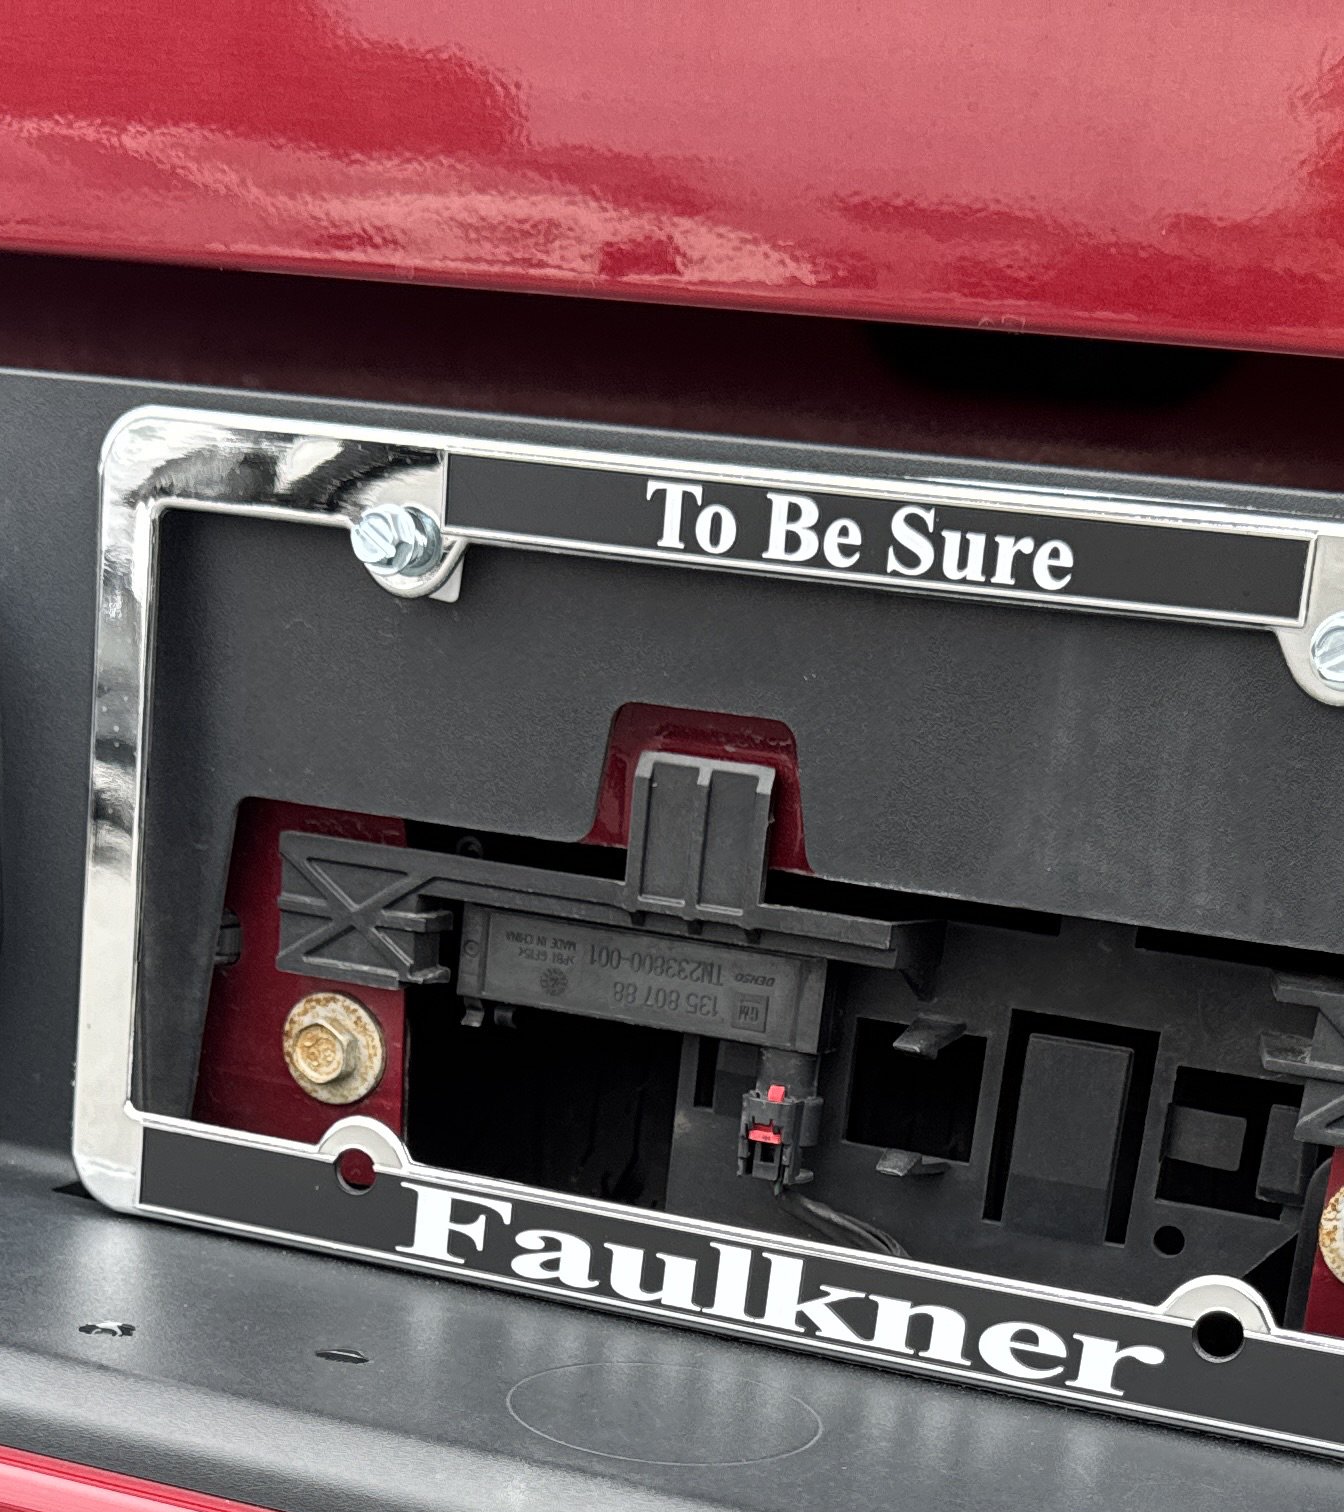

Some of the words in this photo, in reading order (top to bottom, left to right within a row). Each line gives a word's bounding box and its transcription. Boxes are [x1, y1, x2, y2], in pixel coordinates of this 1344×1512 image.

[646, 479, 736, 554] To
[761, 492, 862, 568] Be
[886, 505, 1075, 591] Sure
[537, 935, 547, 947] IN
[549, 937, 576, 951] MADE
[734, 972, 776, 987] DENSO
[613, 981, 638, 1005] 88
[643, 985, 681, 1011] 807
[685, 991, 719, 1018] 135
[737, 1004, 760, 1022] GM
[394, 1181, 1165, 1396] Faulkner
